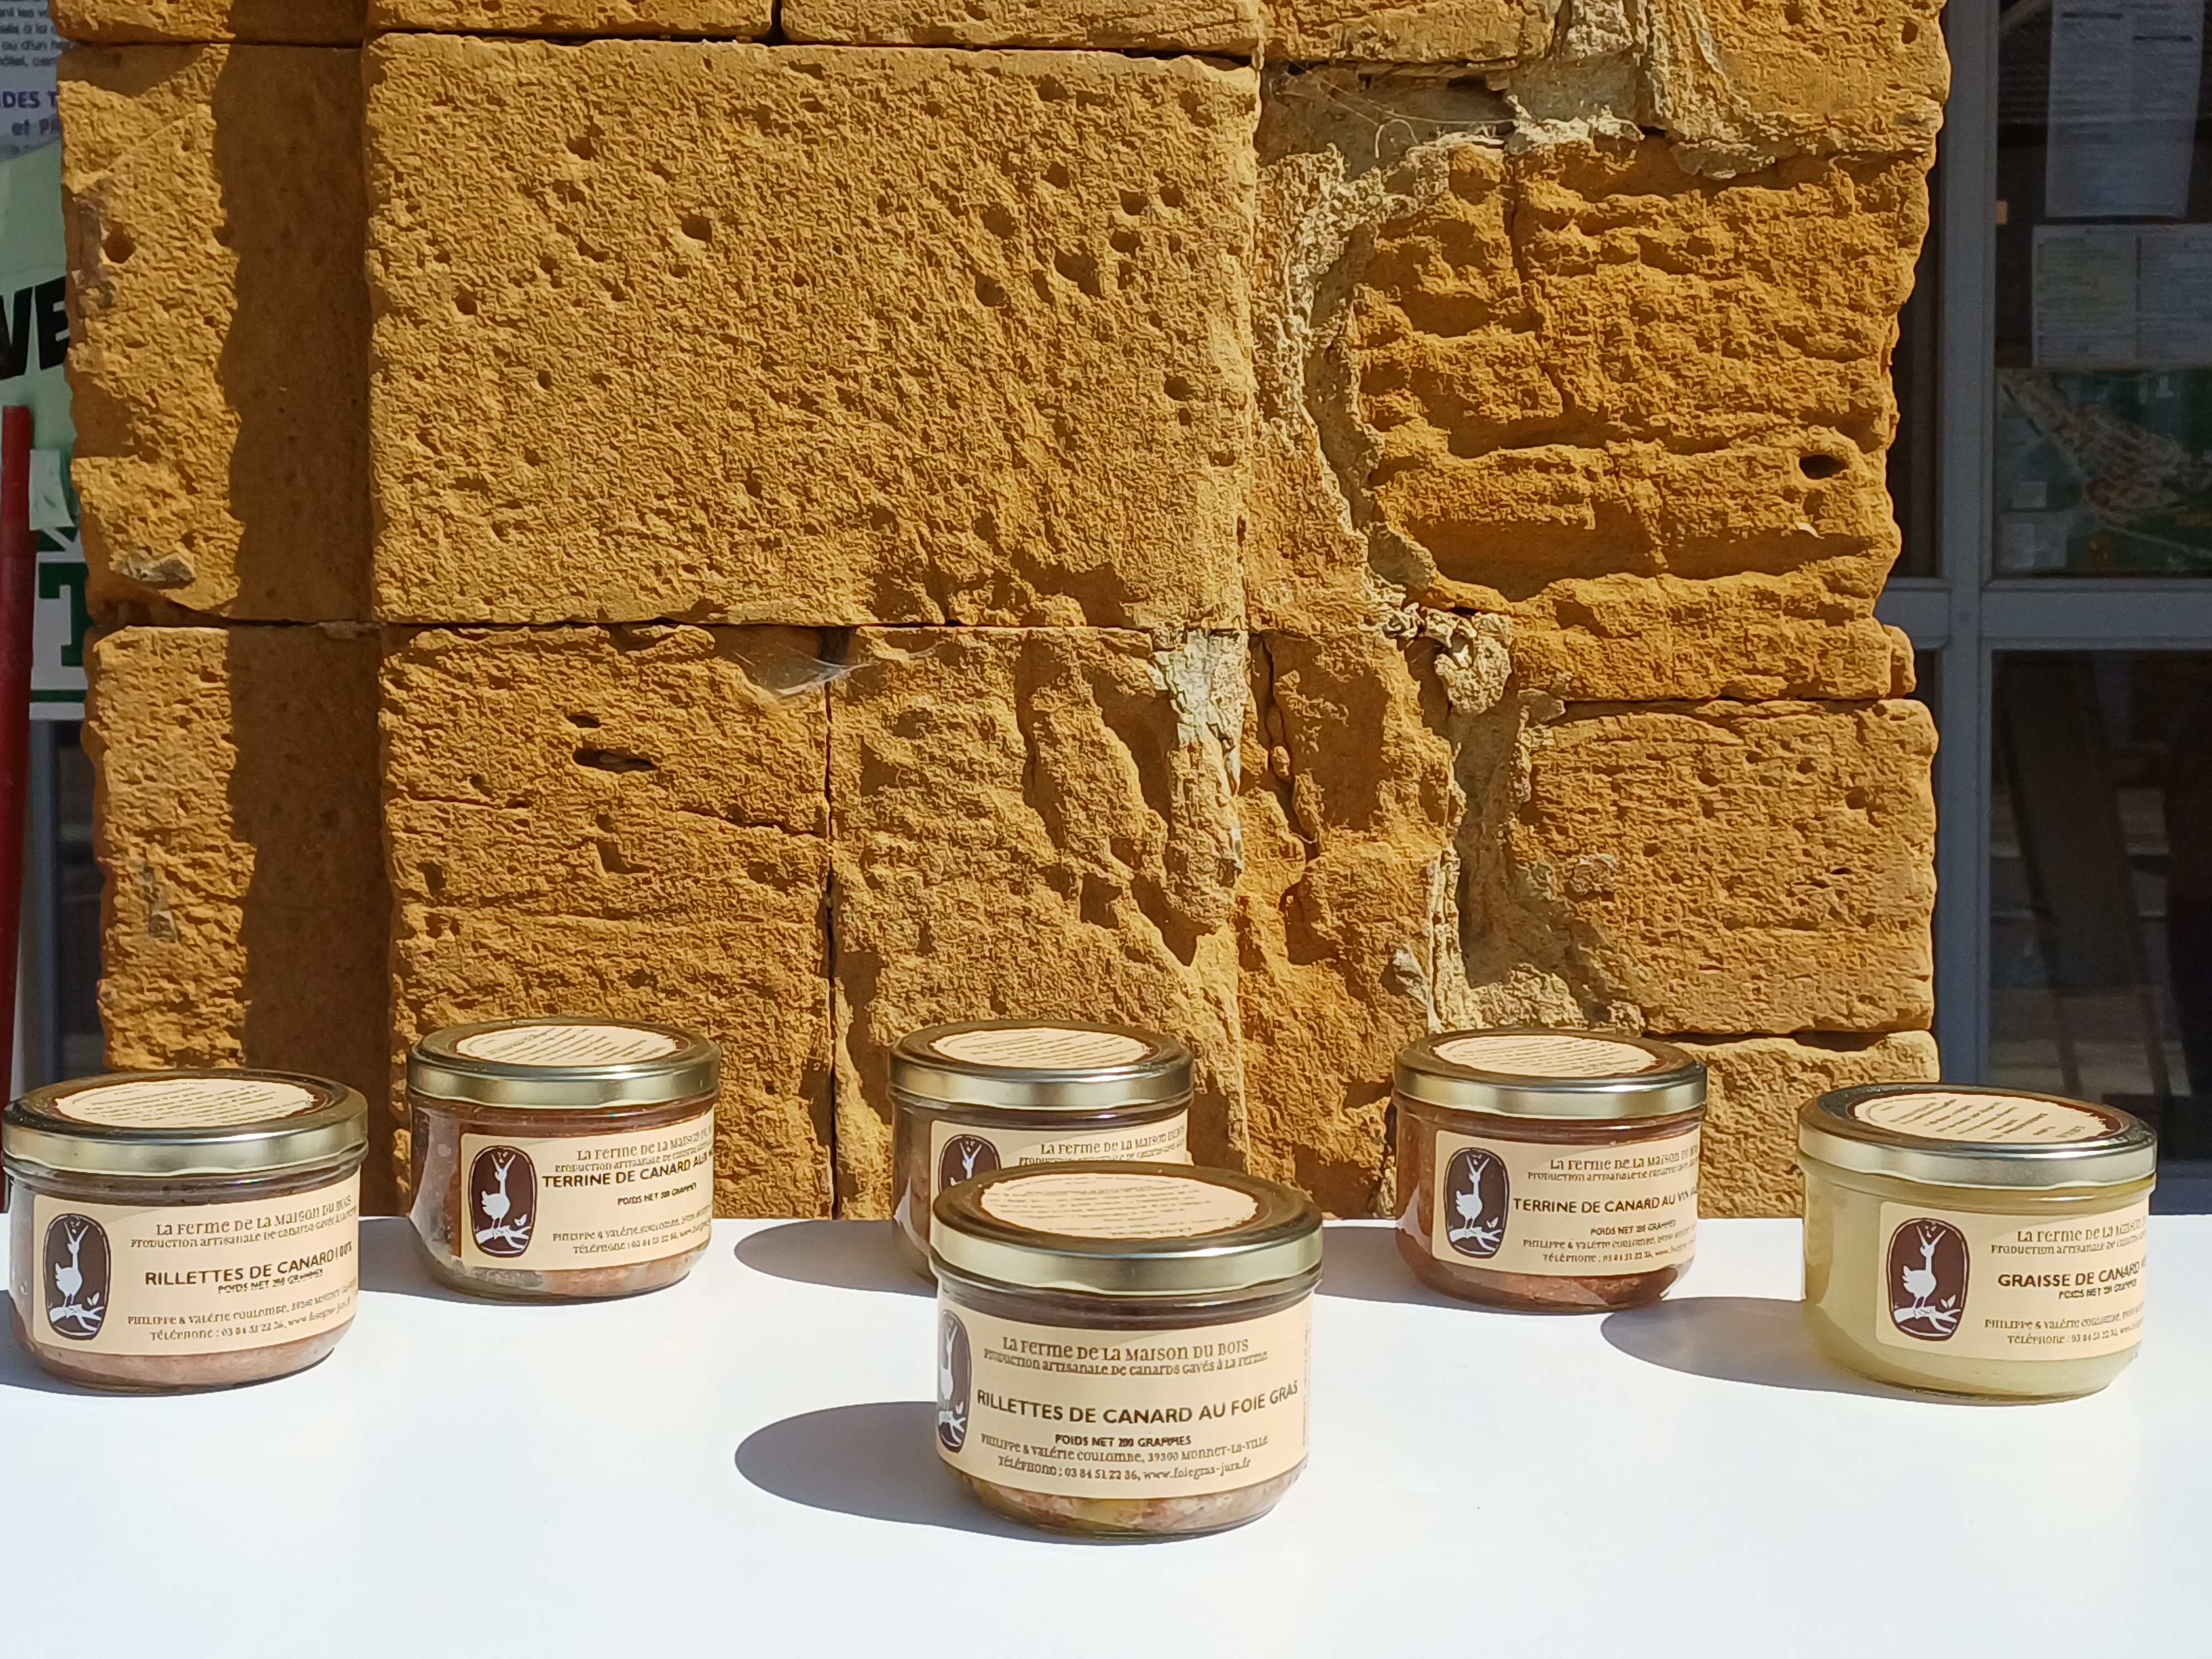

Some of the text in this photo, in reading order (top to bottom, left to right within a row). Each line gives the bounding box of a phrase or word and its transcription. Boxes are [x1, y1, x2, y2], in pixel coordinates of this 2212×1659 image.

[0, 91, 40, 108] DES
[542, 1172, 611, 1188] TERRINE
[615, 1170, 635, 1184] DE
[640, 1159, 690, 1180] CANARD
[1513, 1198, 1577, 1213] TERRINE
[1582, 1202, 1601, 1213] DE
[1604, 1197, 1660, 1213] CANARD
[1661, 1194, 1676, 1207] AU
[145, 1267, 243, 1286] RILLETTES
[250, 1264, 272, 1279] DE
[277, 1249, 334, 1274] CANARD
[1997, 1260, 2140, 1287] GRAISSE DE CANARD
[977, 1380, 1298, 1424] RILLETTES DE CANARD AU FOIE GRAS
[1055, 1434, 1088, 1447] POIDS
[1092, 1437, 1114, 1447] NET
